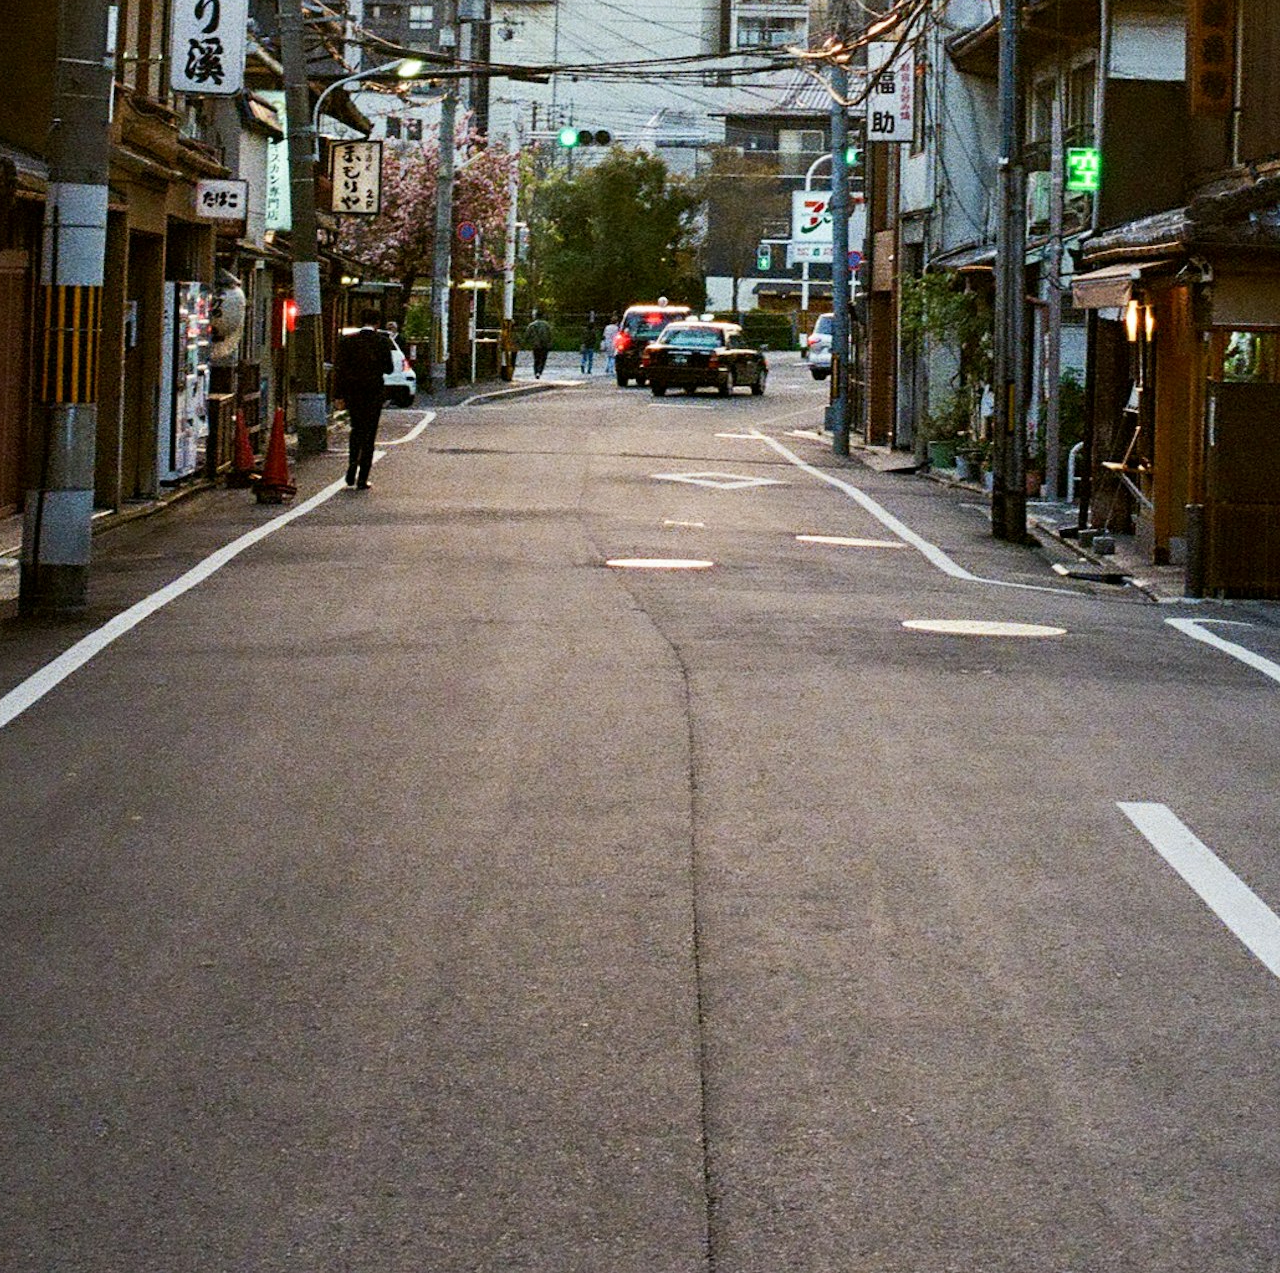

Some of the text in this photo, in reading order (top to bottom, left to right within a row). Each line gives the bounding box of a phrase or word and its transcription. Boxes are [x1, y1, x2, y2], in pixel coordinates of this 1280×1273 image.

[1071, 151, 1098, 188] 空
[202, 190, 239, 209] たばこ
